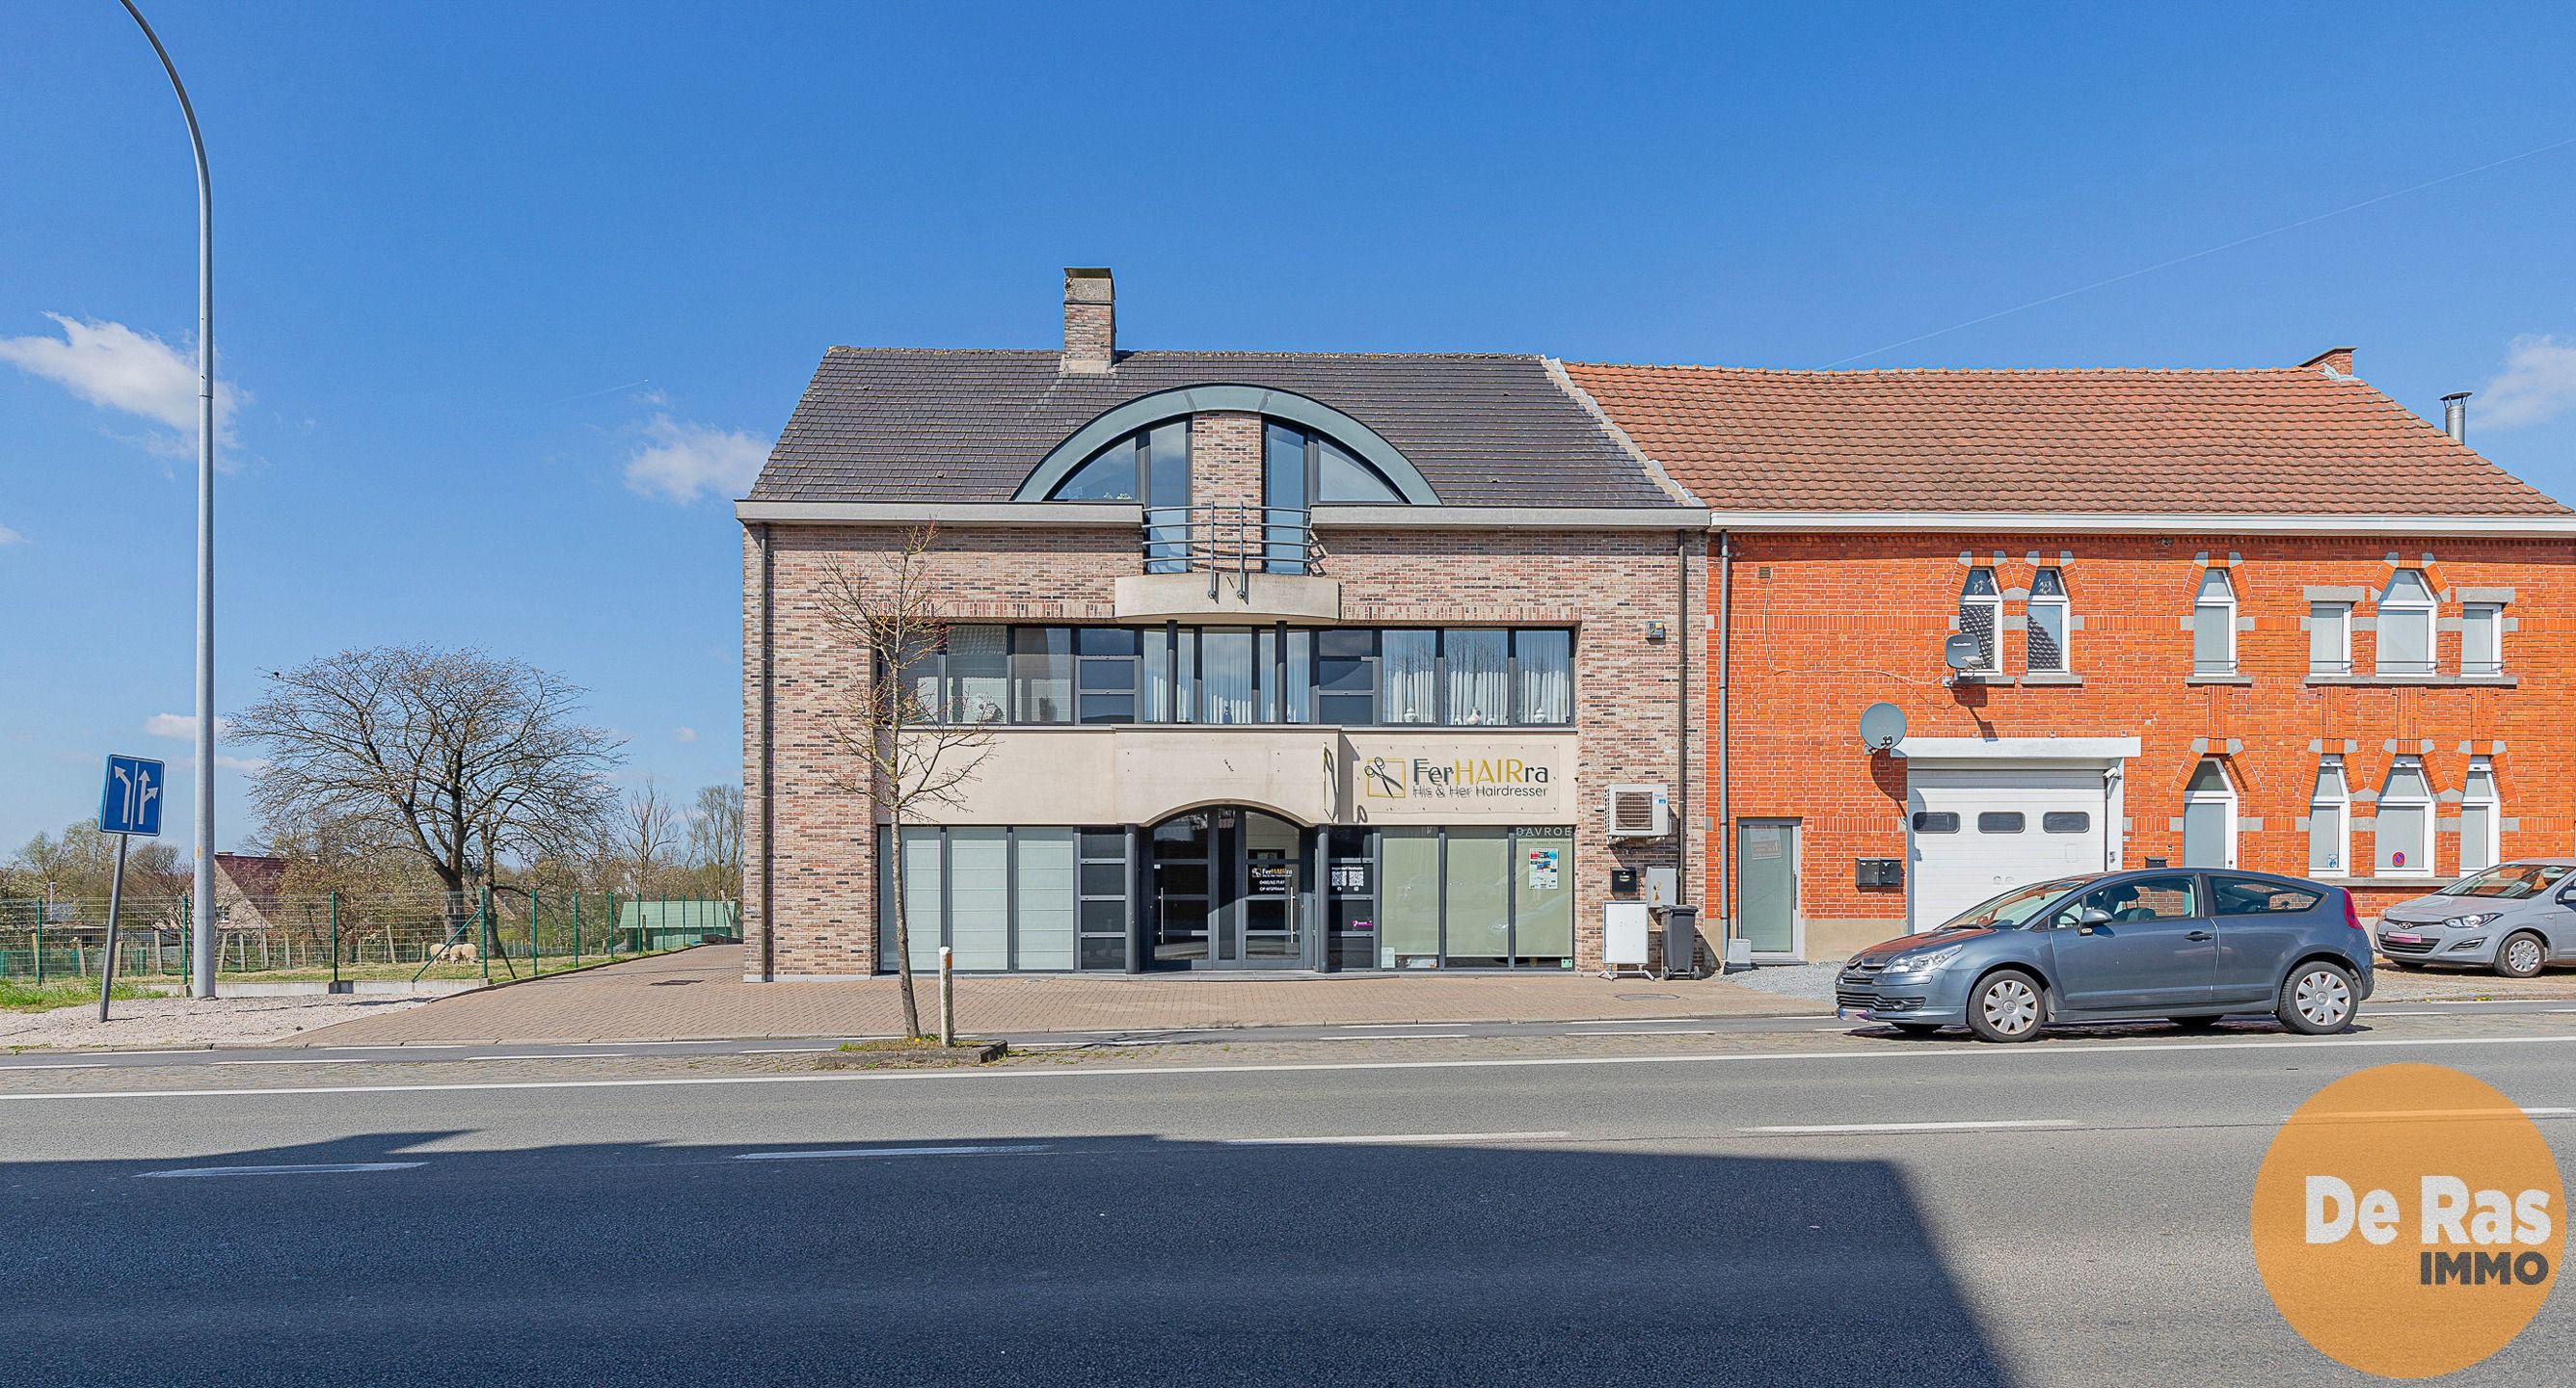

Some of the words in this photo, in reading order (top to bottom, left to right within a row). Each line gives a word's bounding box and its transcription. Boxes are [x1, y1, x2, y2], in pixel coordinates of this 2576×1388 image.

[1413, 758, 1548, 786] FerHAIRra
[1412, 785, 1432, 798] His
[1435, 785, 1446, 798] &
[1449, 786, 1472, 798] Her
[1475, 785, 1548, 798] Hairdresser
[1516, 827, 1573, 837] DAVROE
